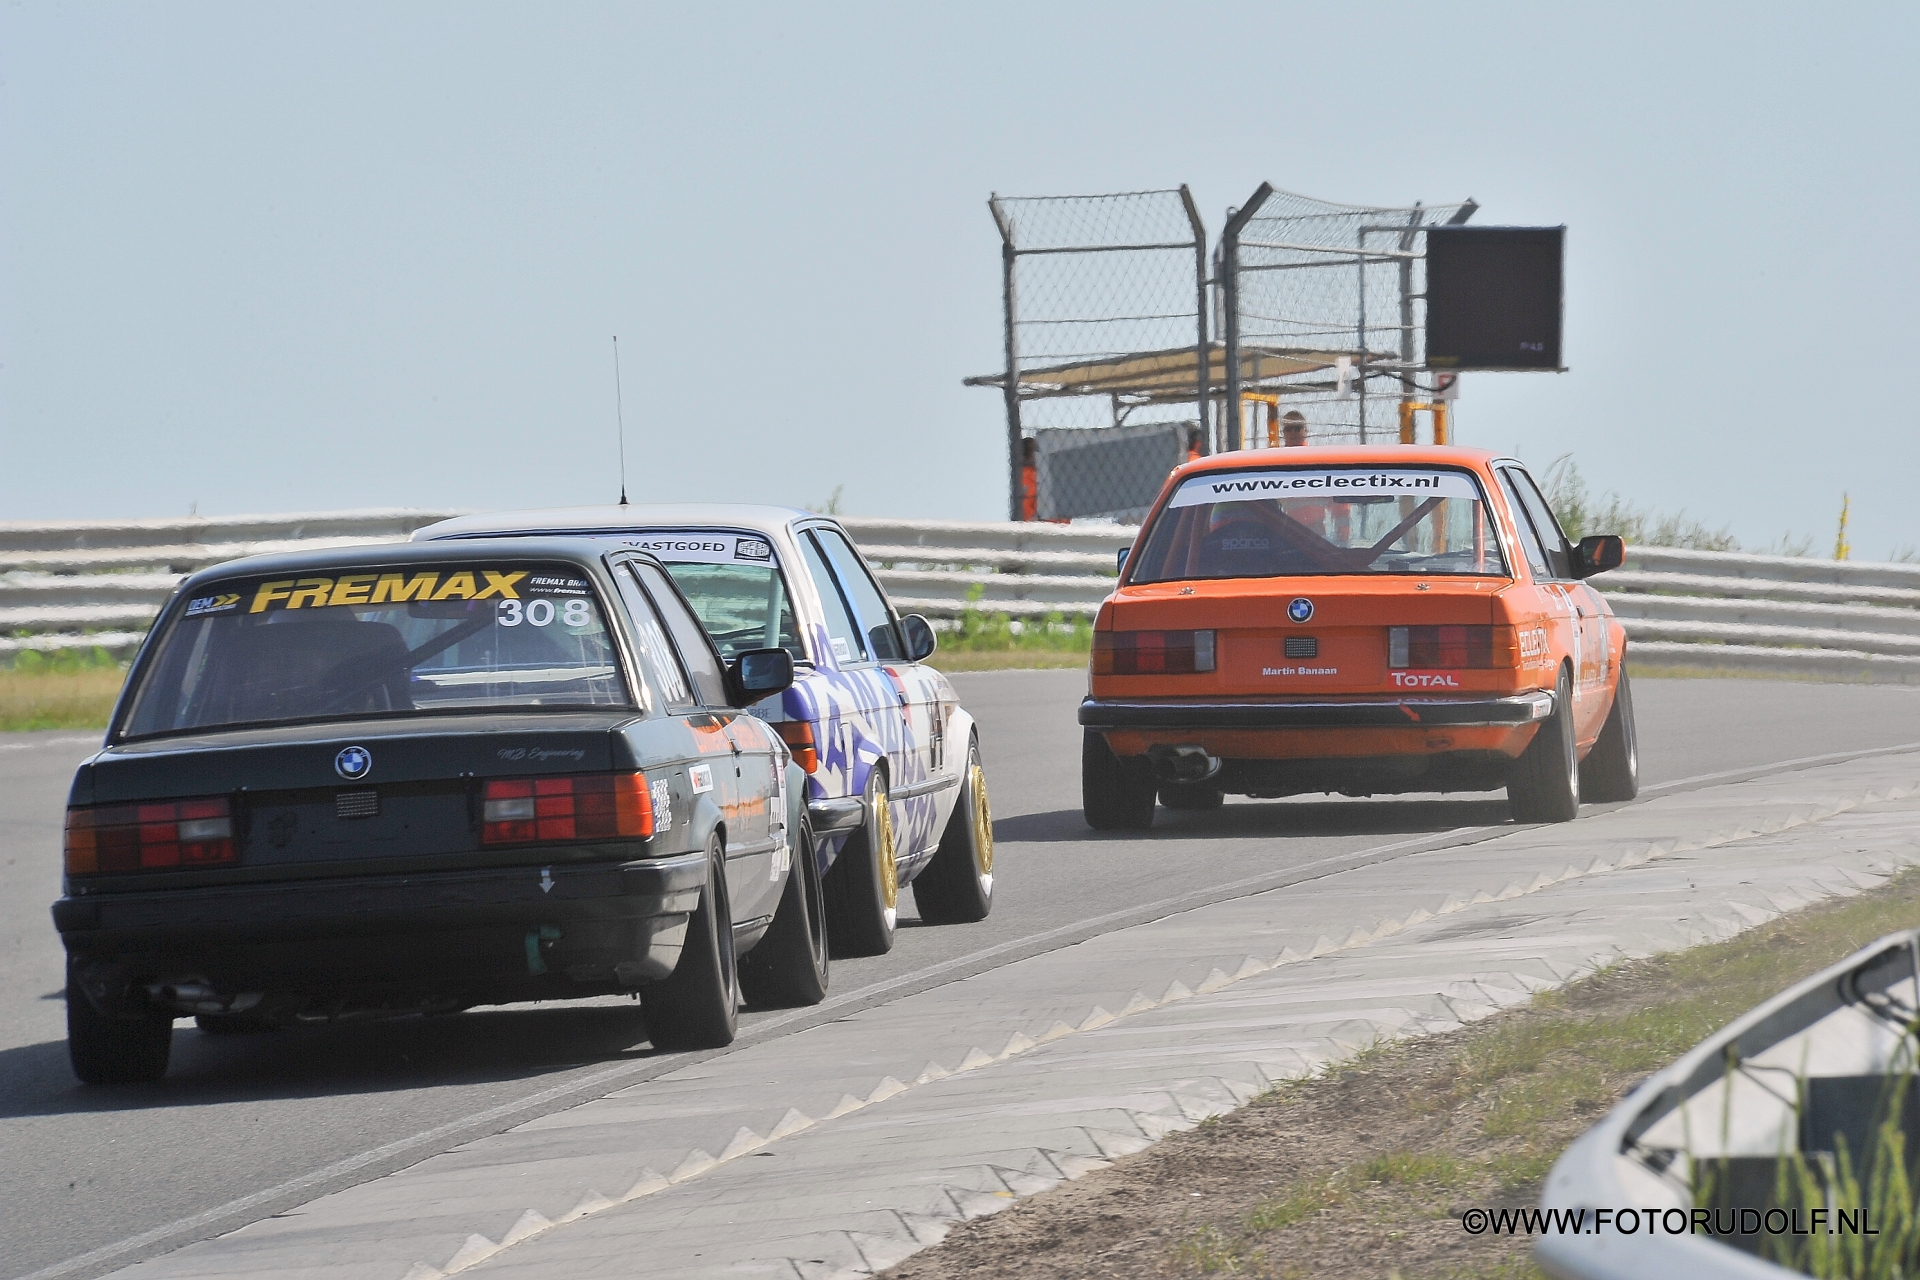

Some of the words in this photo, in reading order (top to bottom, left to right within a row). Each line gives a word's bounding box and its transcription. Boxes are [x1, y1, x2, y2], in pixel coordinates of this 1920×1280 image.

[1211, 474, 1440, 494] www.eclectix.nl
[628, 541, 725, 552] VASTGOED
[530, 577, 565, 586] FREMAX
[249, 570, 530, 614] FREMAX
[498, 599, 590, 627] 308
[1262, 667, 1295, 676] Martin
[1298, 667, 1338, 675] Banaan
